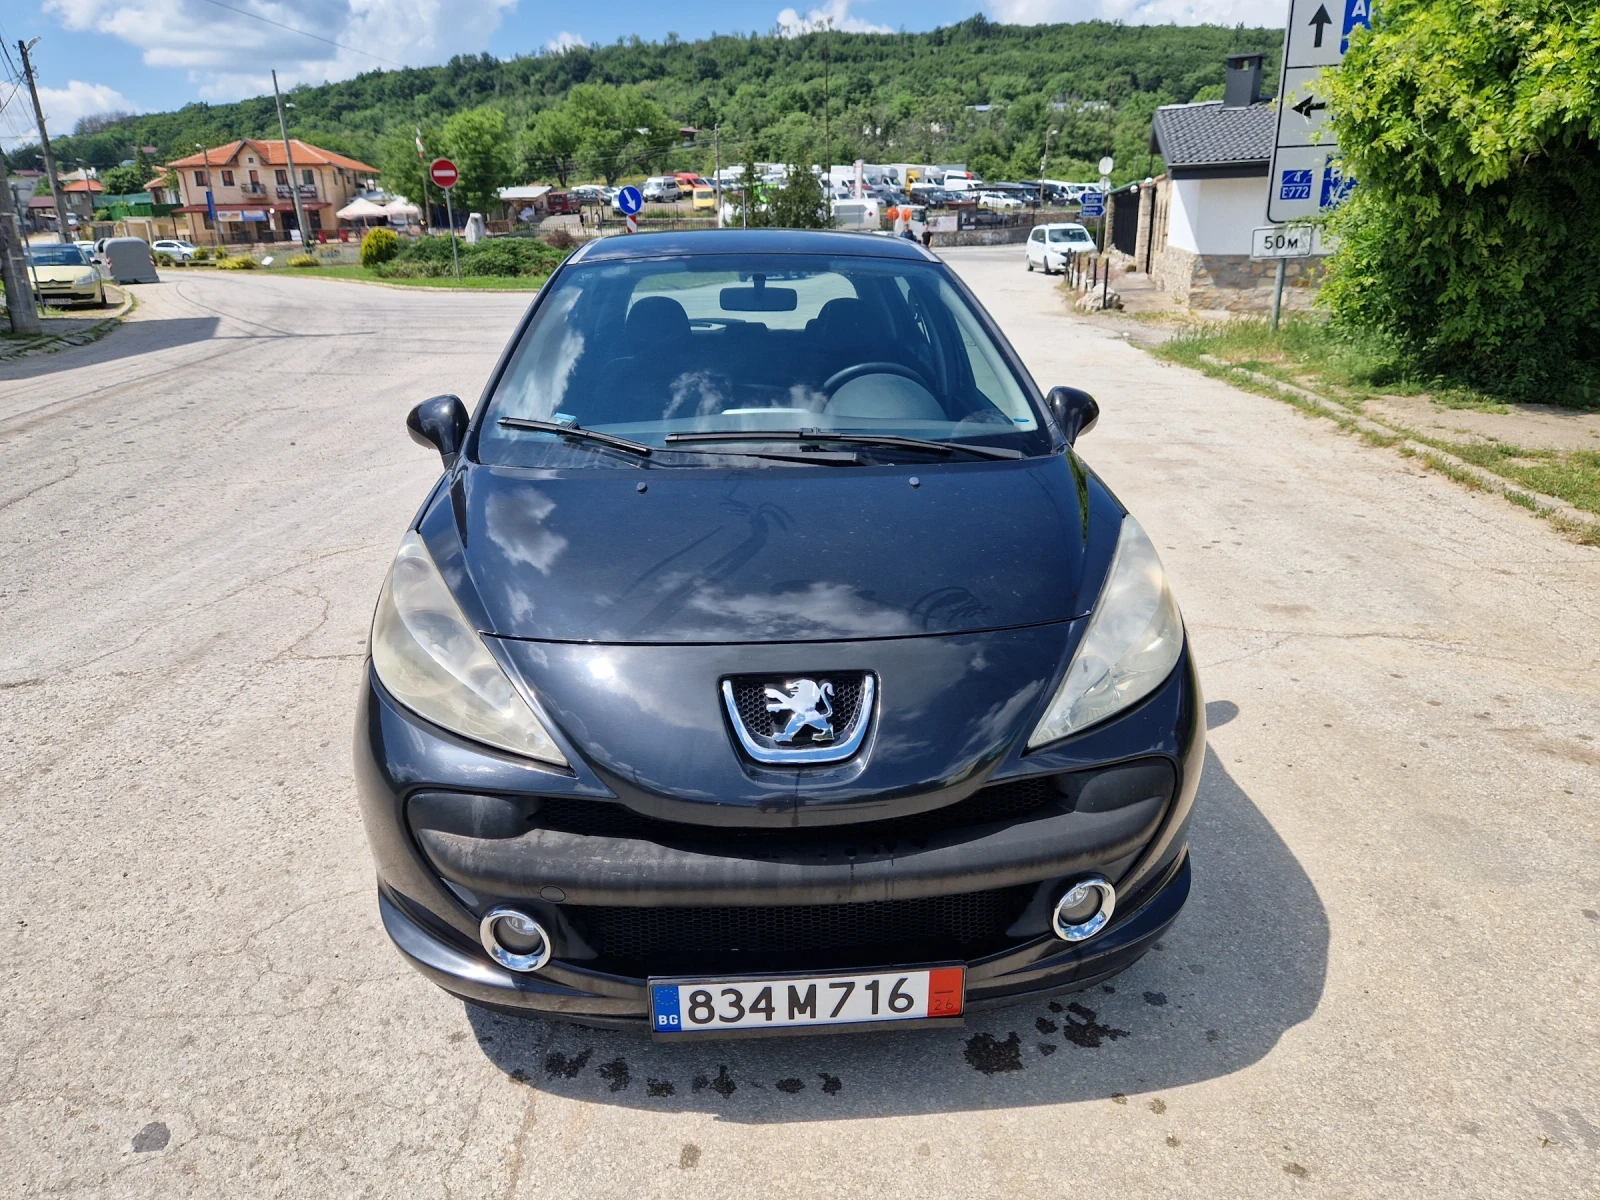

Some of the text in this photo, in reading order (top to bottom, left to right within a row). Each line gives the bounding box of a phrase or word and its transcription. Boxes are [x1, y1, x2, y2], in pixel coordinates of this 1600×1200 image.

[1281, 186, 1309, 199] E772
[933, 998, 954, 1011] 26
[658, 1014, 679, 1026] BG
